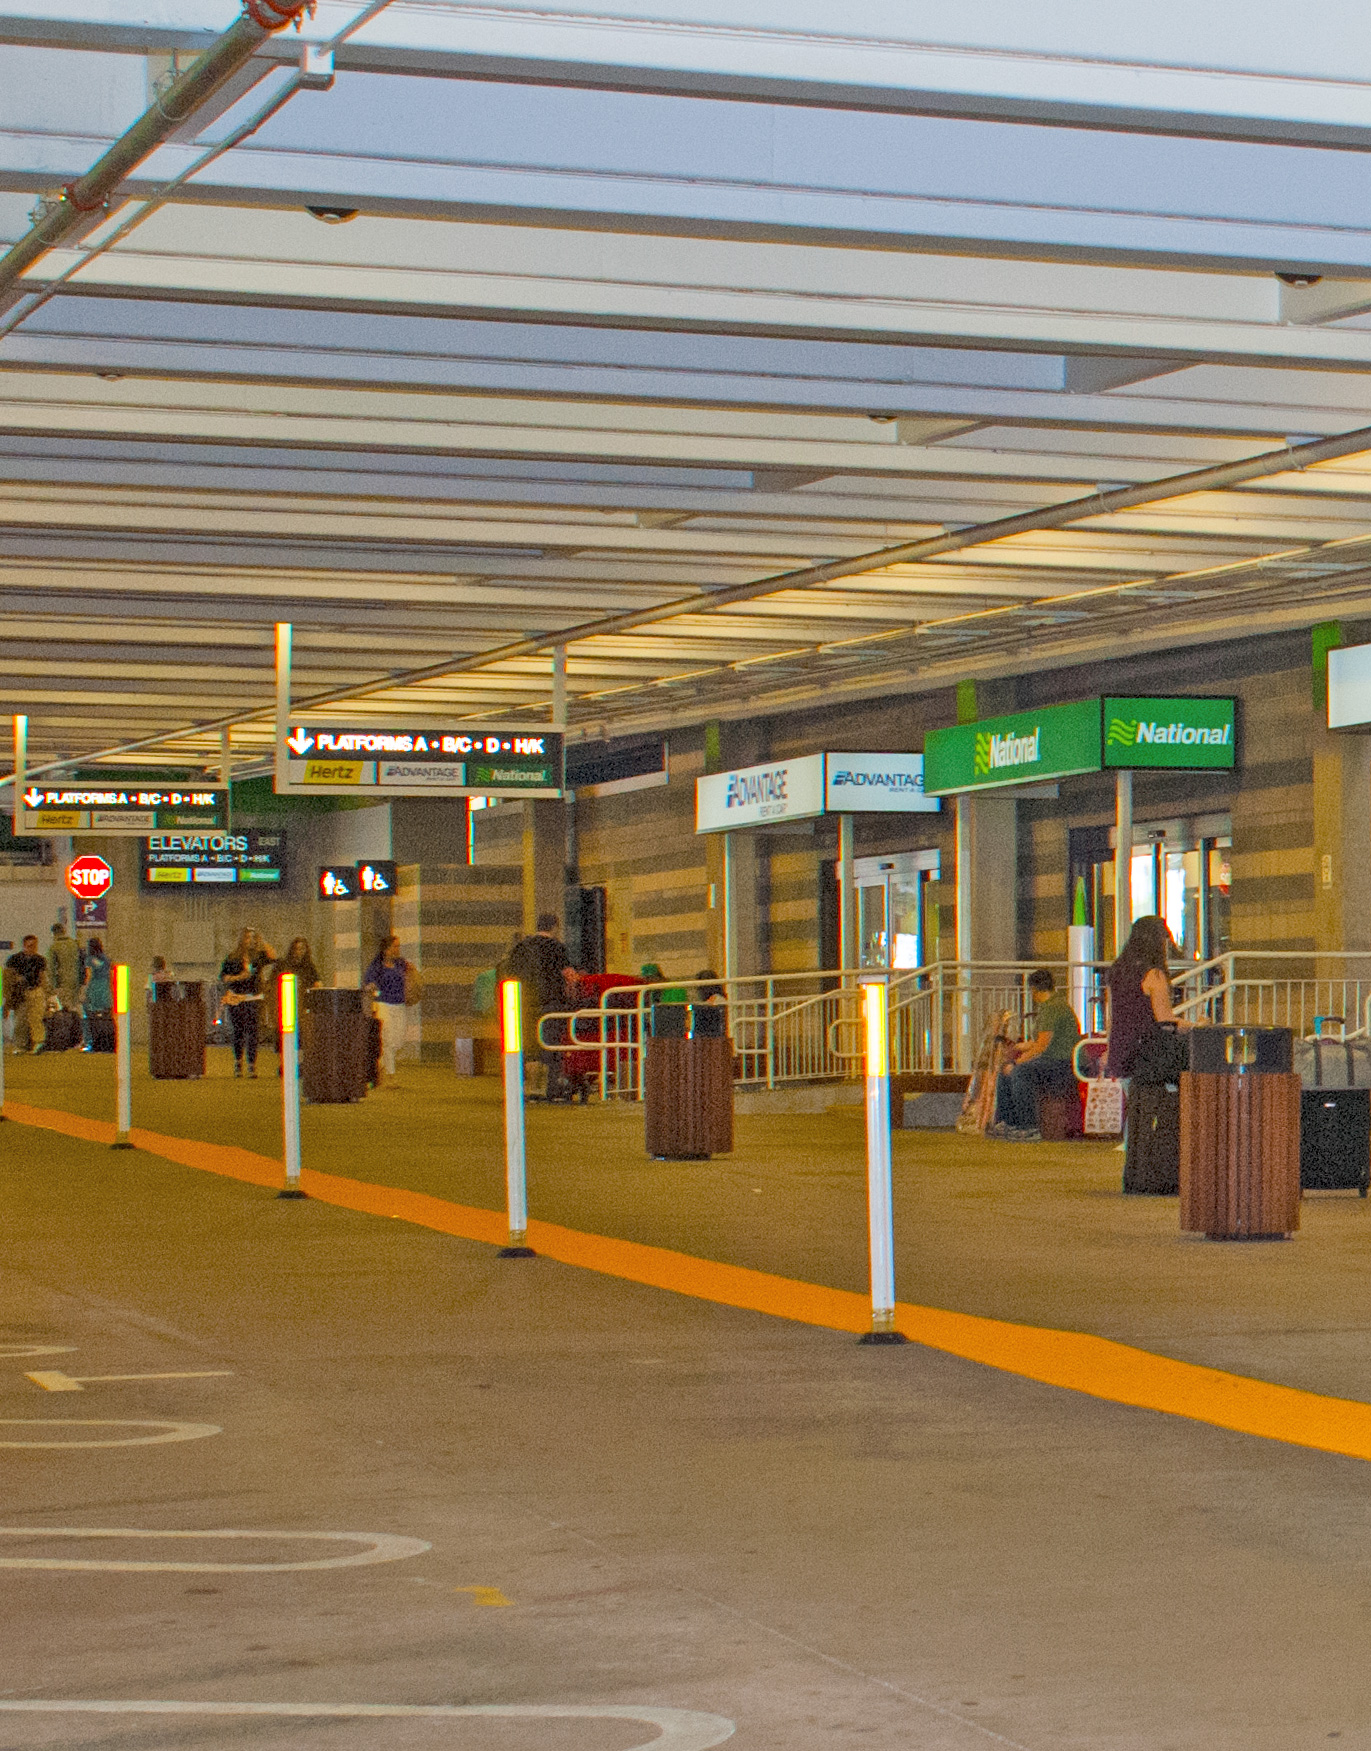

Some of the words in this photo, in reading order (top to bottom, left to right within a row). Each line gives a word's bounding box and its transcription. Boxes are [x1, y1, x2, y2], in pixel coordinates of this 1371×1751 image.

[1136, 721, 1231, 745] National
[316, 734, 413, 751] PLATFORMS
[413, 735, 428, 751] A
[441, 736, 472, 753] B/C
[485, 737, 500, 753] D
[513, 738, 545, 755] H/K
[989, 726, 1041, 769] National
[311, 765, 354, 779] Hertz
[394, 767, 459, 777] ADVANTAGE
[491, 767, 547, 781] National
[842, 773, 924, 786] ADVANTAG
[733, 769, 788, 806] ADVANTAGE
[45, 792, 117, 804] PLATFORMS
[171, 793, 183, 805] D
[148, 836, 249, 850] ELEVATORS
[149, 854, 200, 862] PLATFORMS
[71, 868, 110, 886] STOP
